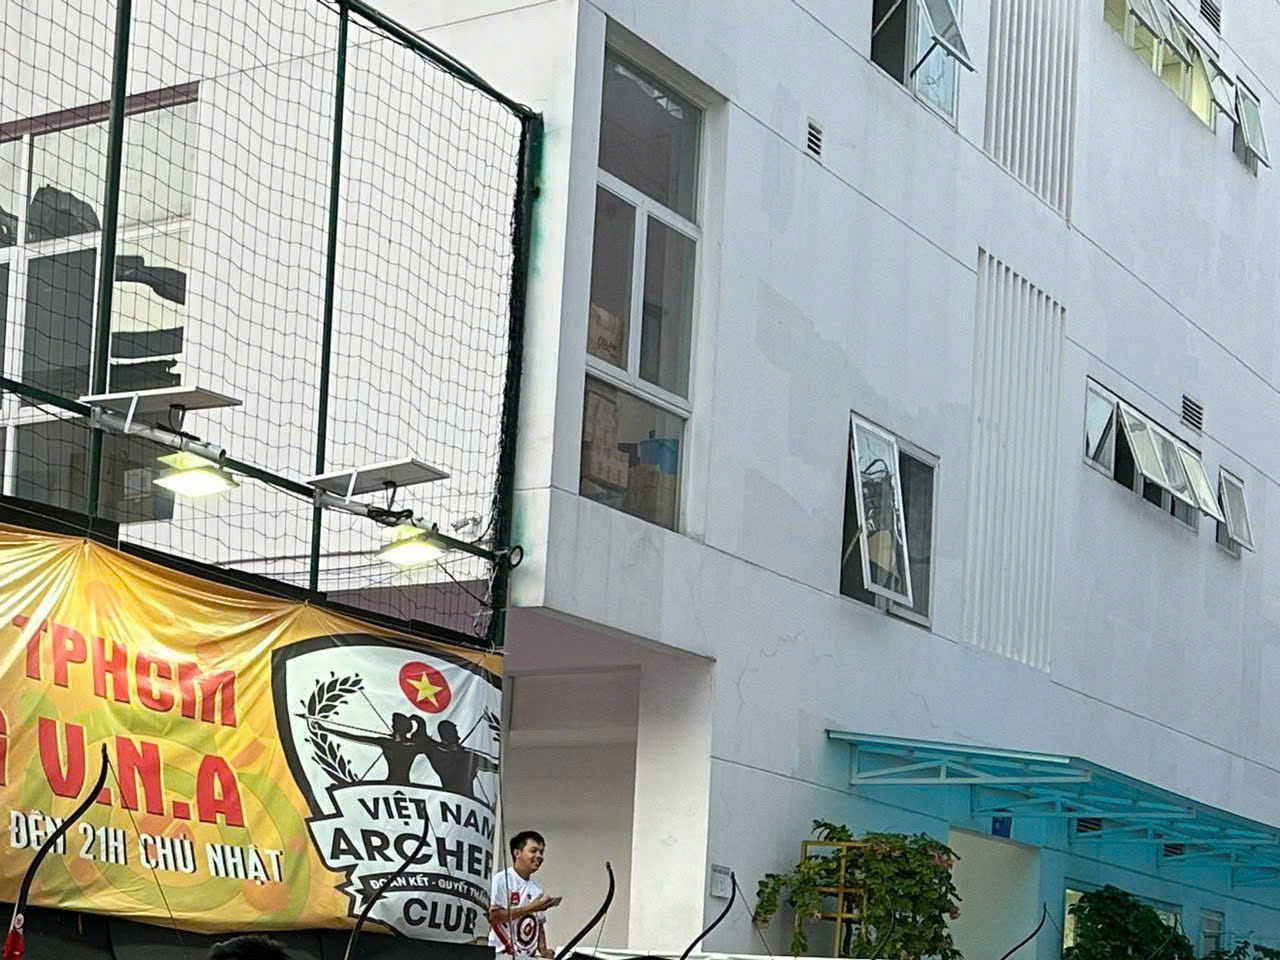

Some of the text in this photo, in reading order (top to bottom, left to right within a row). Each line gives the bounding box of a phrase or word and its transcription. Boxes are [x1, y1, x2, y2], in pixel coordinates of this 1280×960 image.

[12, 613, 237, 728] TPHCM
[357, 790, 426, 826] VIỆT
[79, 822, 128, 866] 21H
[205, 843, 284, 885] NHẬT
[403, 898, 477, 935] CLUB
